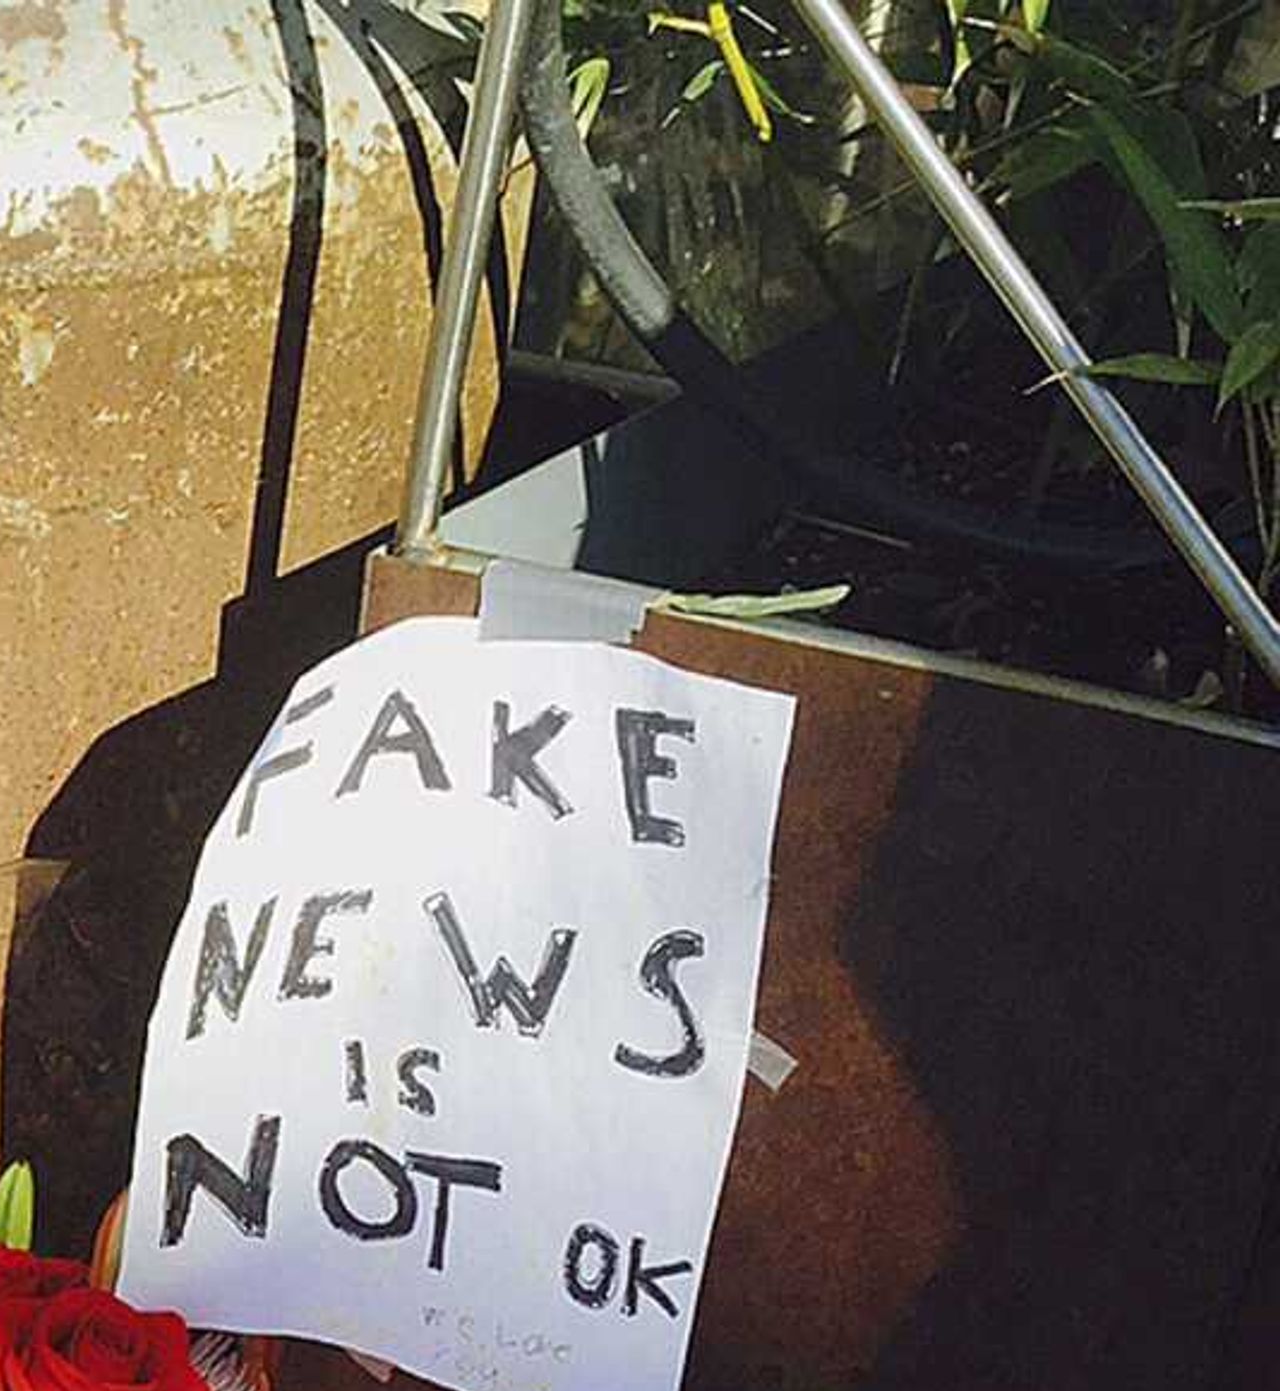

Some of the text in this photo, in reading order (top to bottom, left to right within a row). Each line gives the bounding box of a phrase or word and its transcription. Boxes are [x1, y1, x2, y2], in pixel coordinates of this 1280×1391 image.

[234, 685, 698, 848] FAKE
[184, 888, 707, 1080] NEWS
[342, 1039, 442, 1117] IS
[158, 1113, 694, 1320] NOT OK
